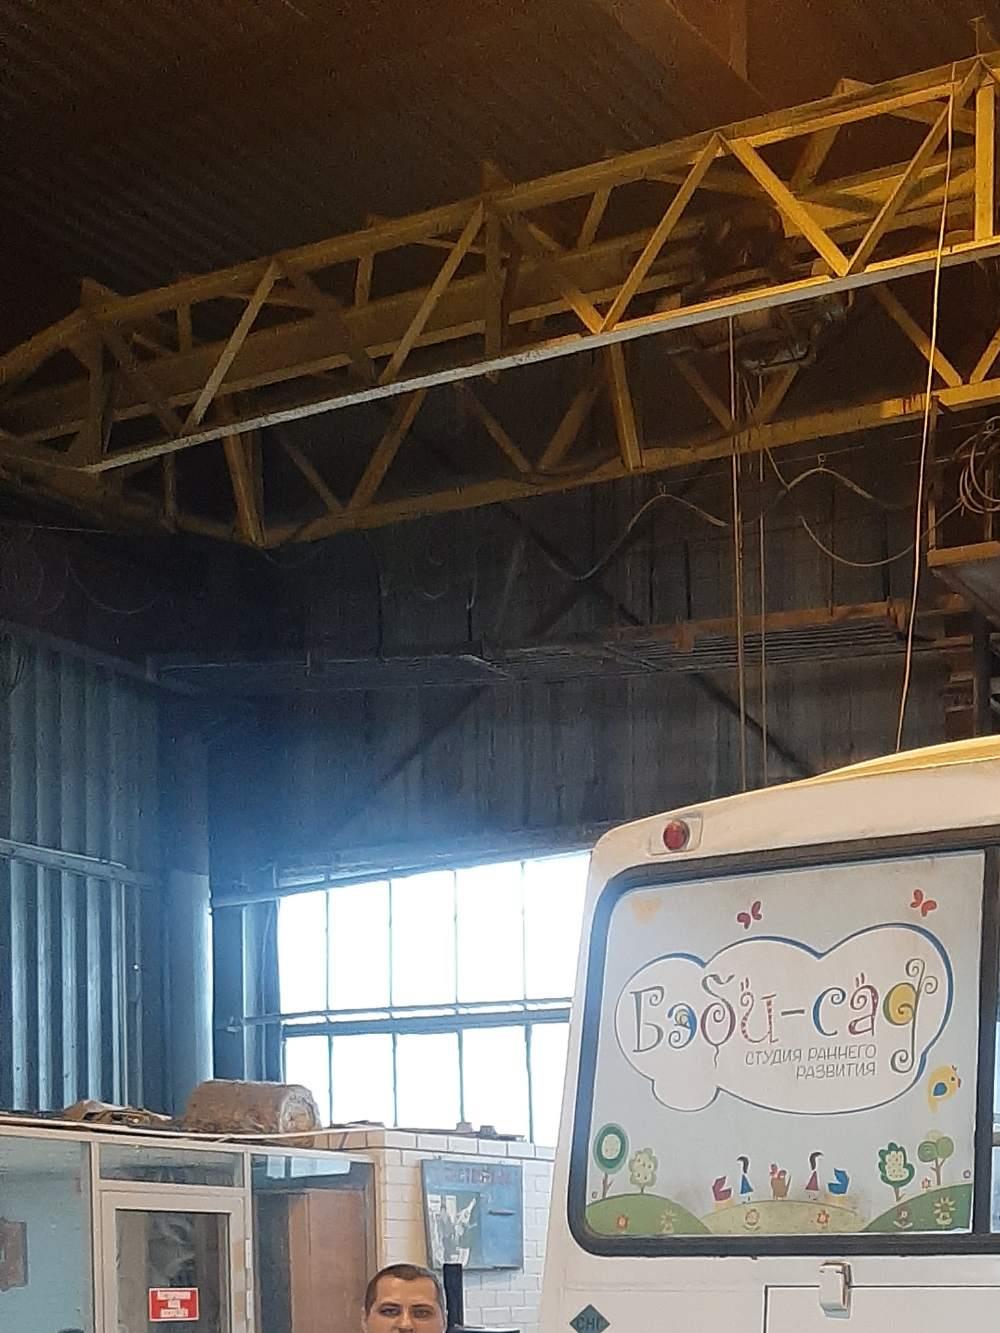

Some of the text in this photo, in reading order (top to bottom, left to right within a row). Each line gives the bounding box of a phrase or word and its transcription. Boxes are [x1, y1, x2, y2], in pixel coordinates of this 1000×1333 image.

[745, 1043, 877, 1066] СТУДИЯ РАННЕГО
[796, 1062, 877, 1079] РАЗВИТИЯ
